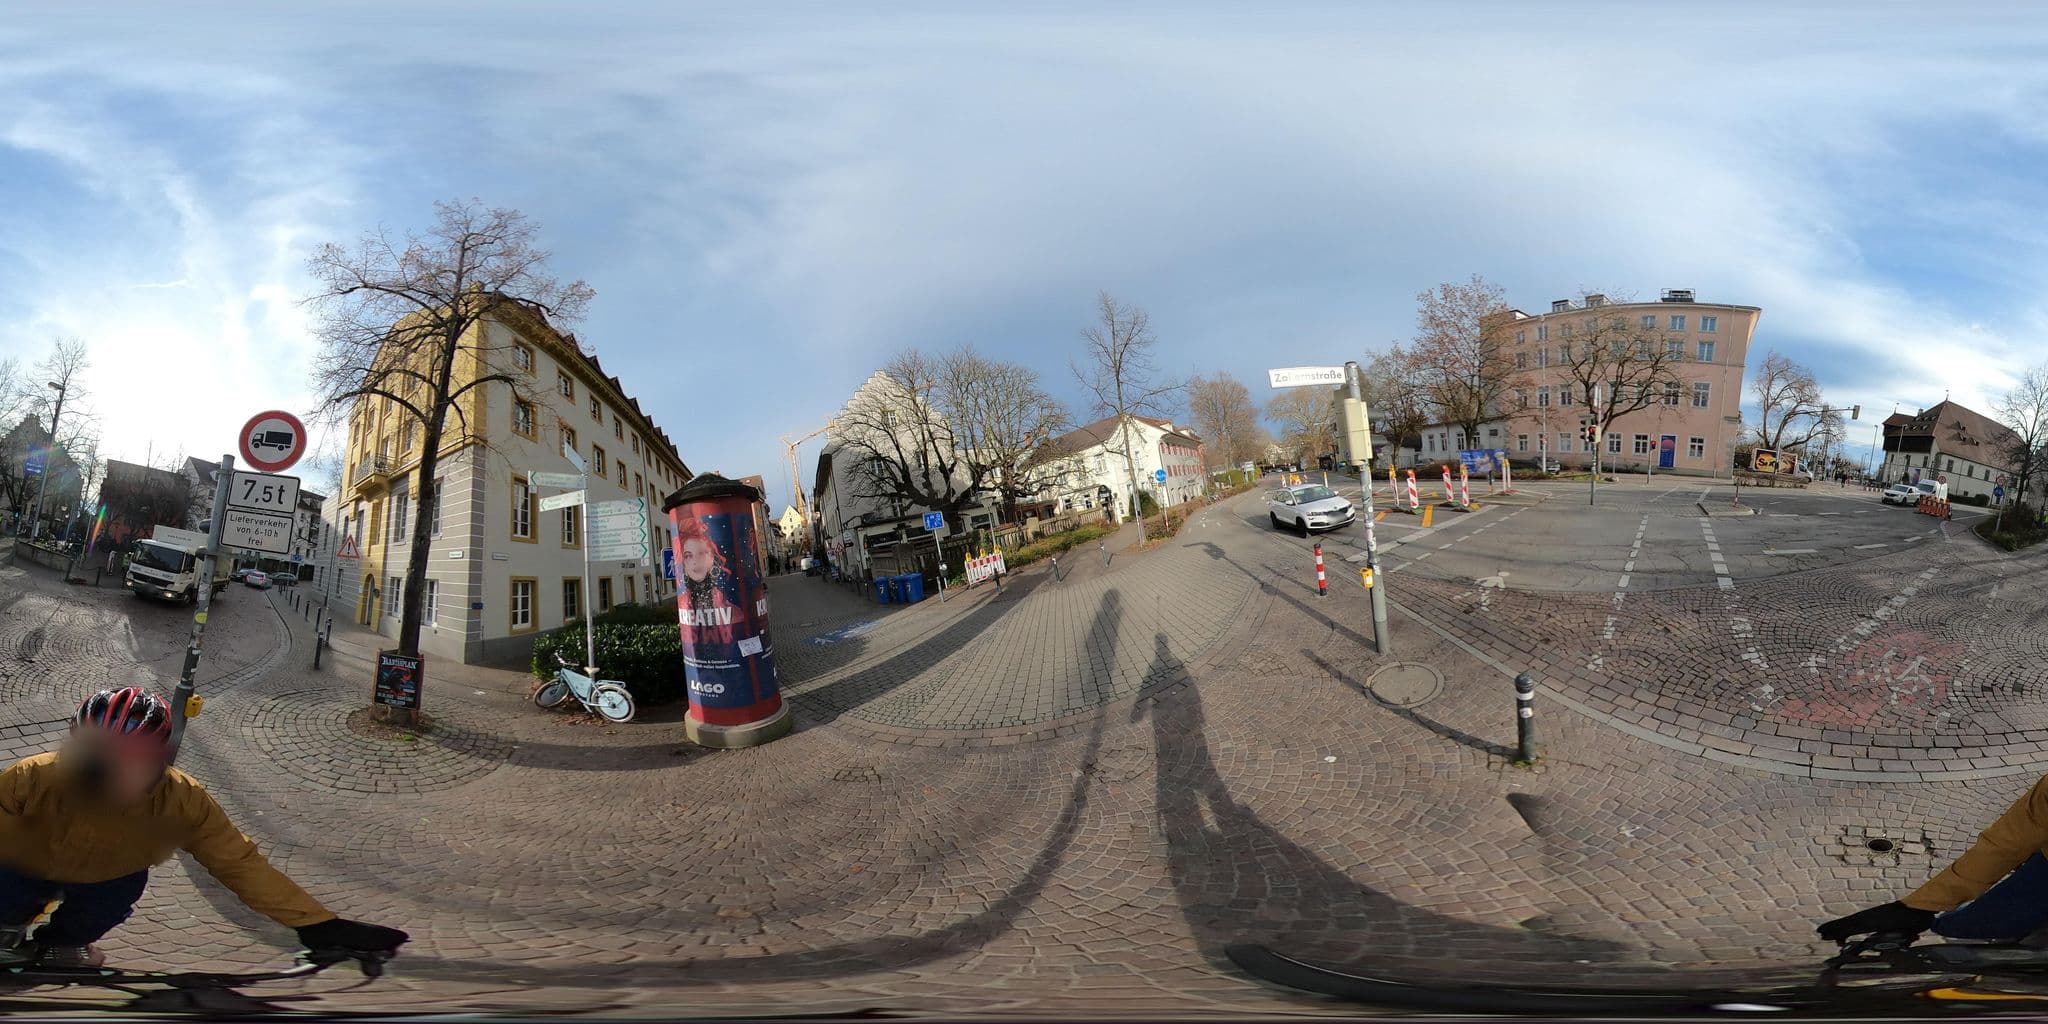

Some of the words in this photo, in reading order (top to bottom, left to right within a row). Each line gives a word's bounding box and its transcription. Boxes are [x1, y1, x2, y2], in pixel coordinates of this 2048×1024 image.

[1274, 370, 1342, 383] Zoernstraße
[230, 514, 288, 529] Lieferverkehr
[236, 526, 251, 534] von
[254, 528, 272, 537] 6-10
[248, 535, 263, 546] frei
[678, 607, 732, 626] KREATIV
[690, 679, 725, 694] LAGO
